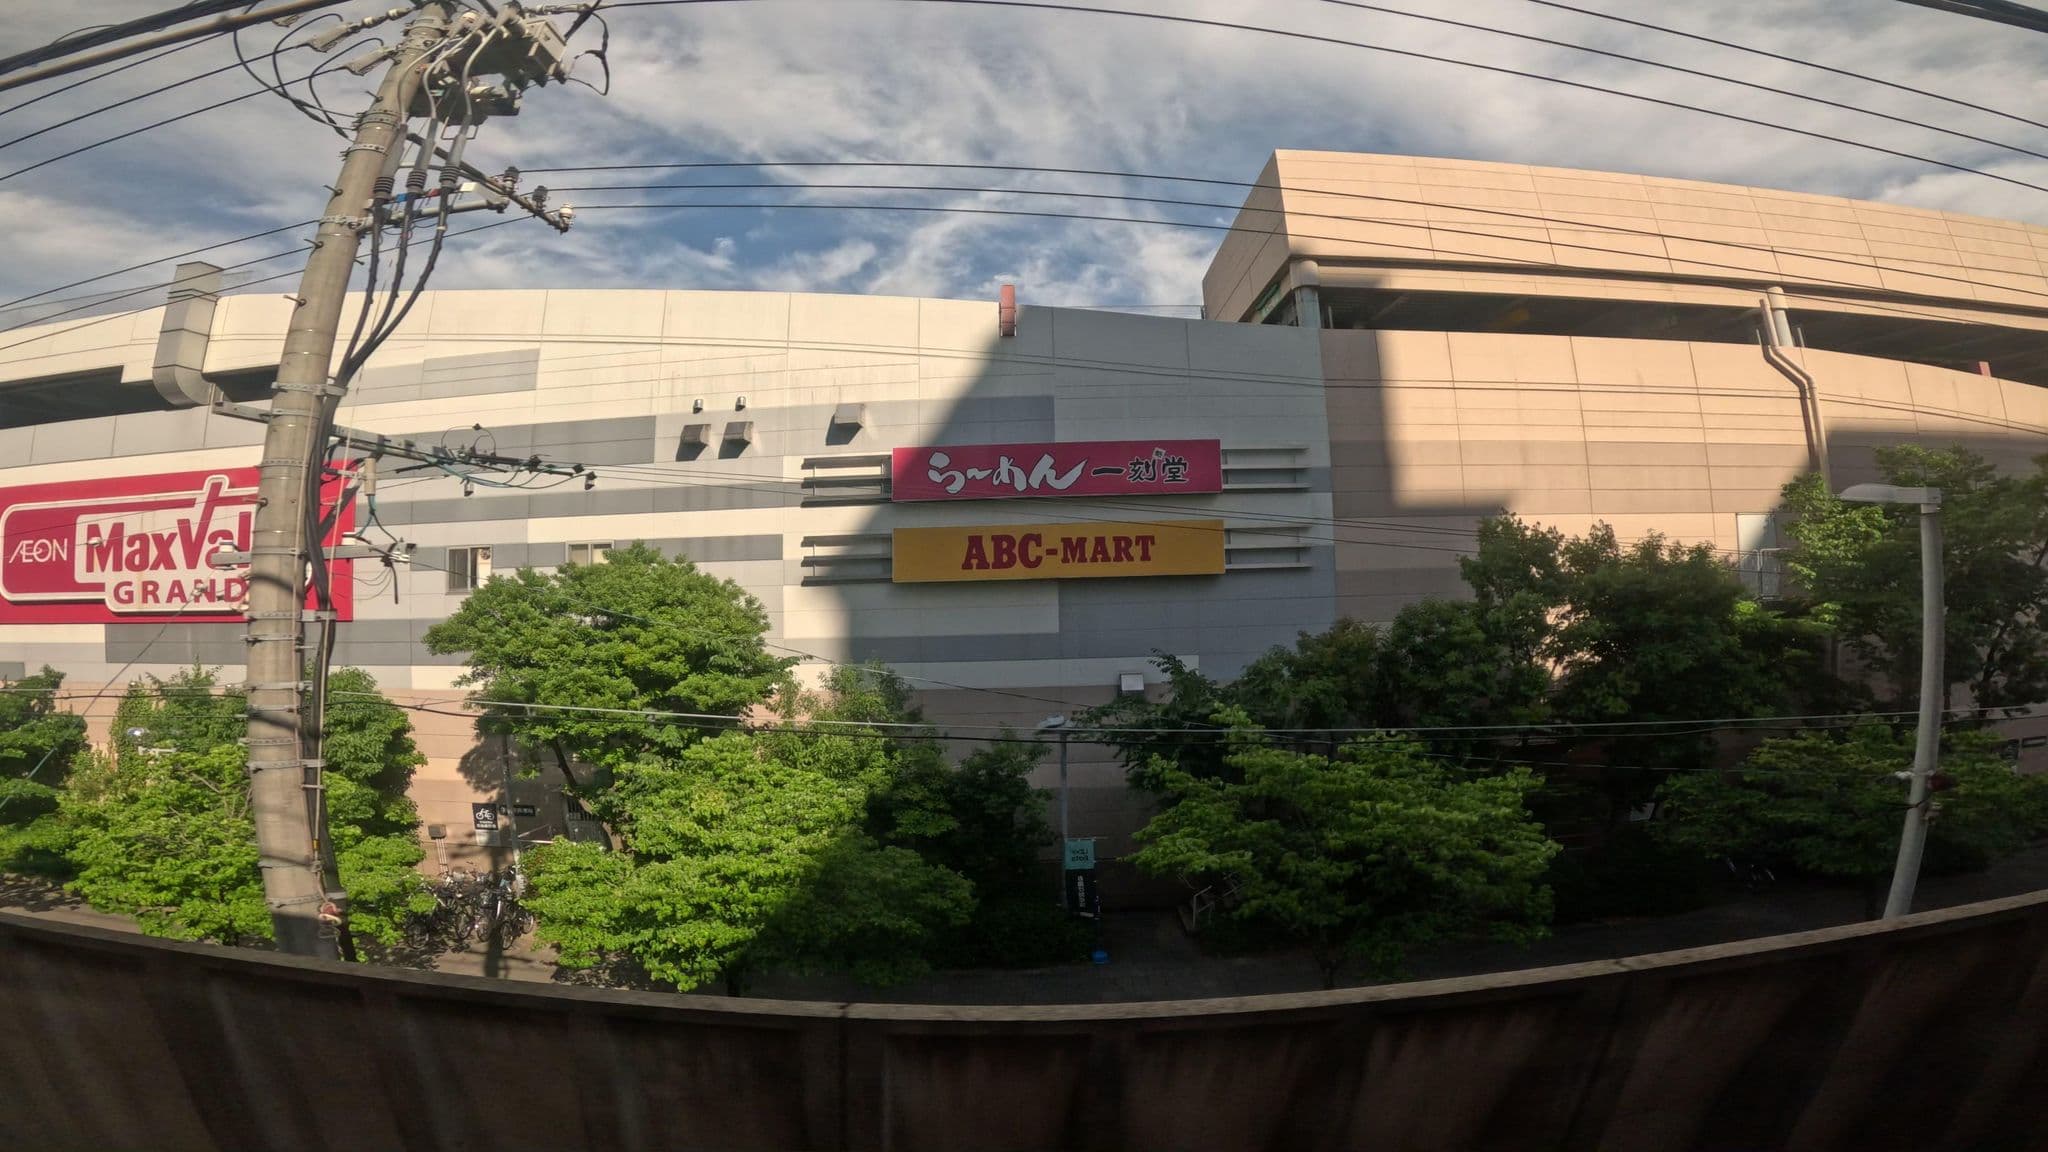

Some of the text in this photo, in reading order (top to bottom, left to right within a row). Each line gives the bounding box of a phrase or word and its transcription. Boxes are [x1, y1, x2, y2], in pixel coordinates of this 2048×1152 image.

[86, 482, 252, 574] MaxVal
[961, 533, 1155, 570] ABC-MART
[113, 577, 249, 605] GRAND
